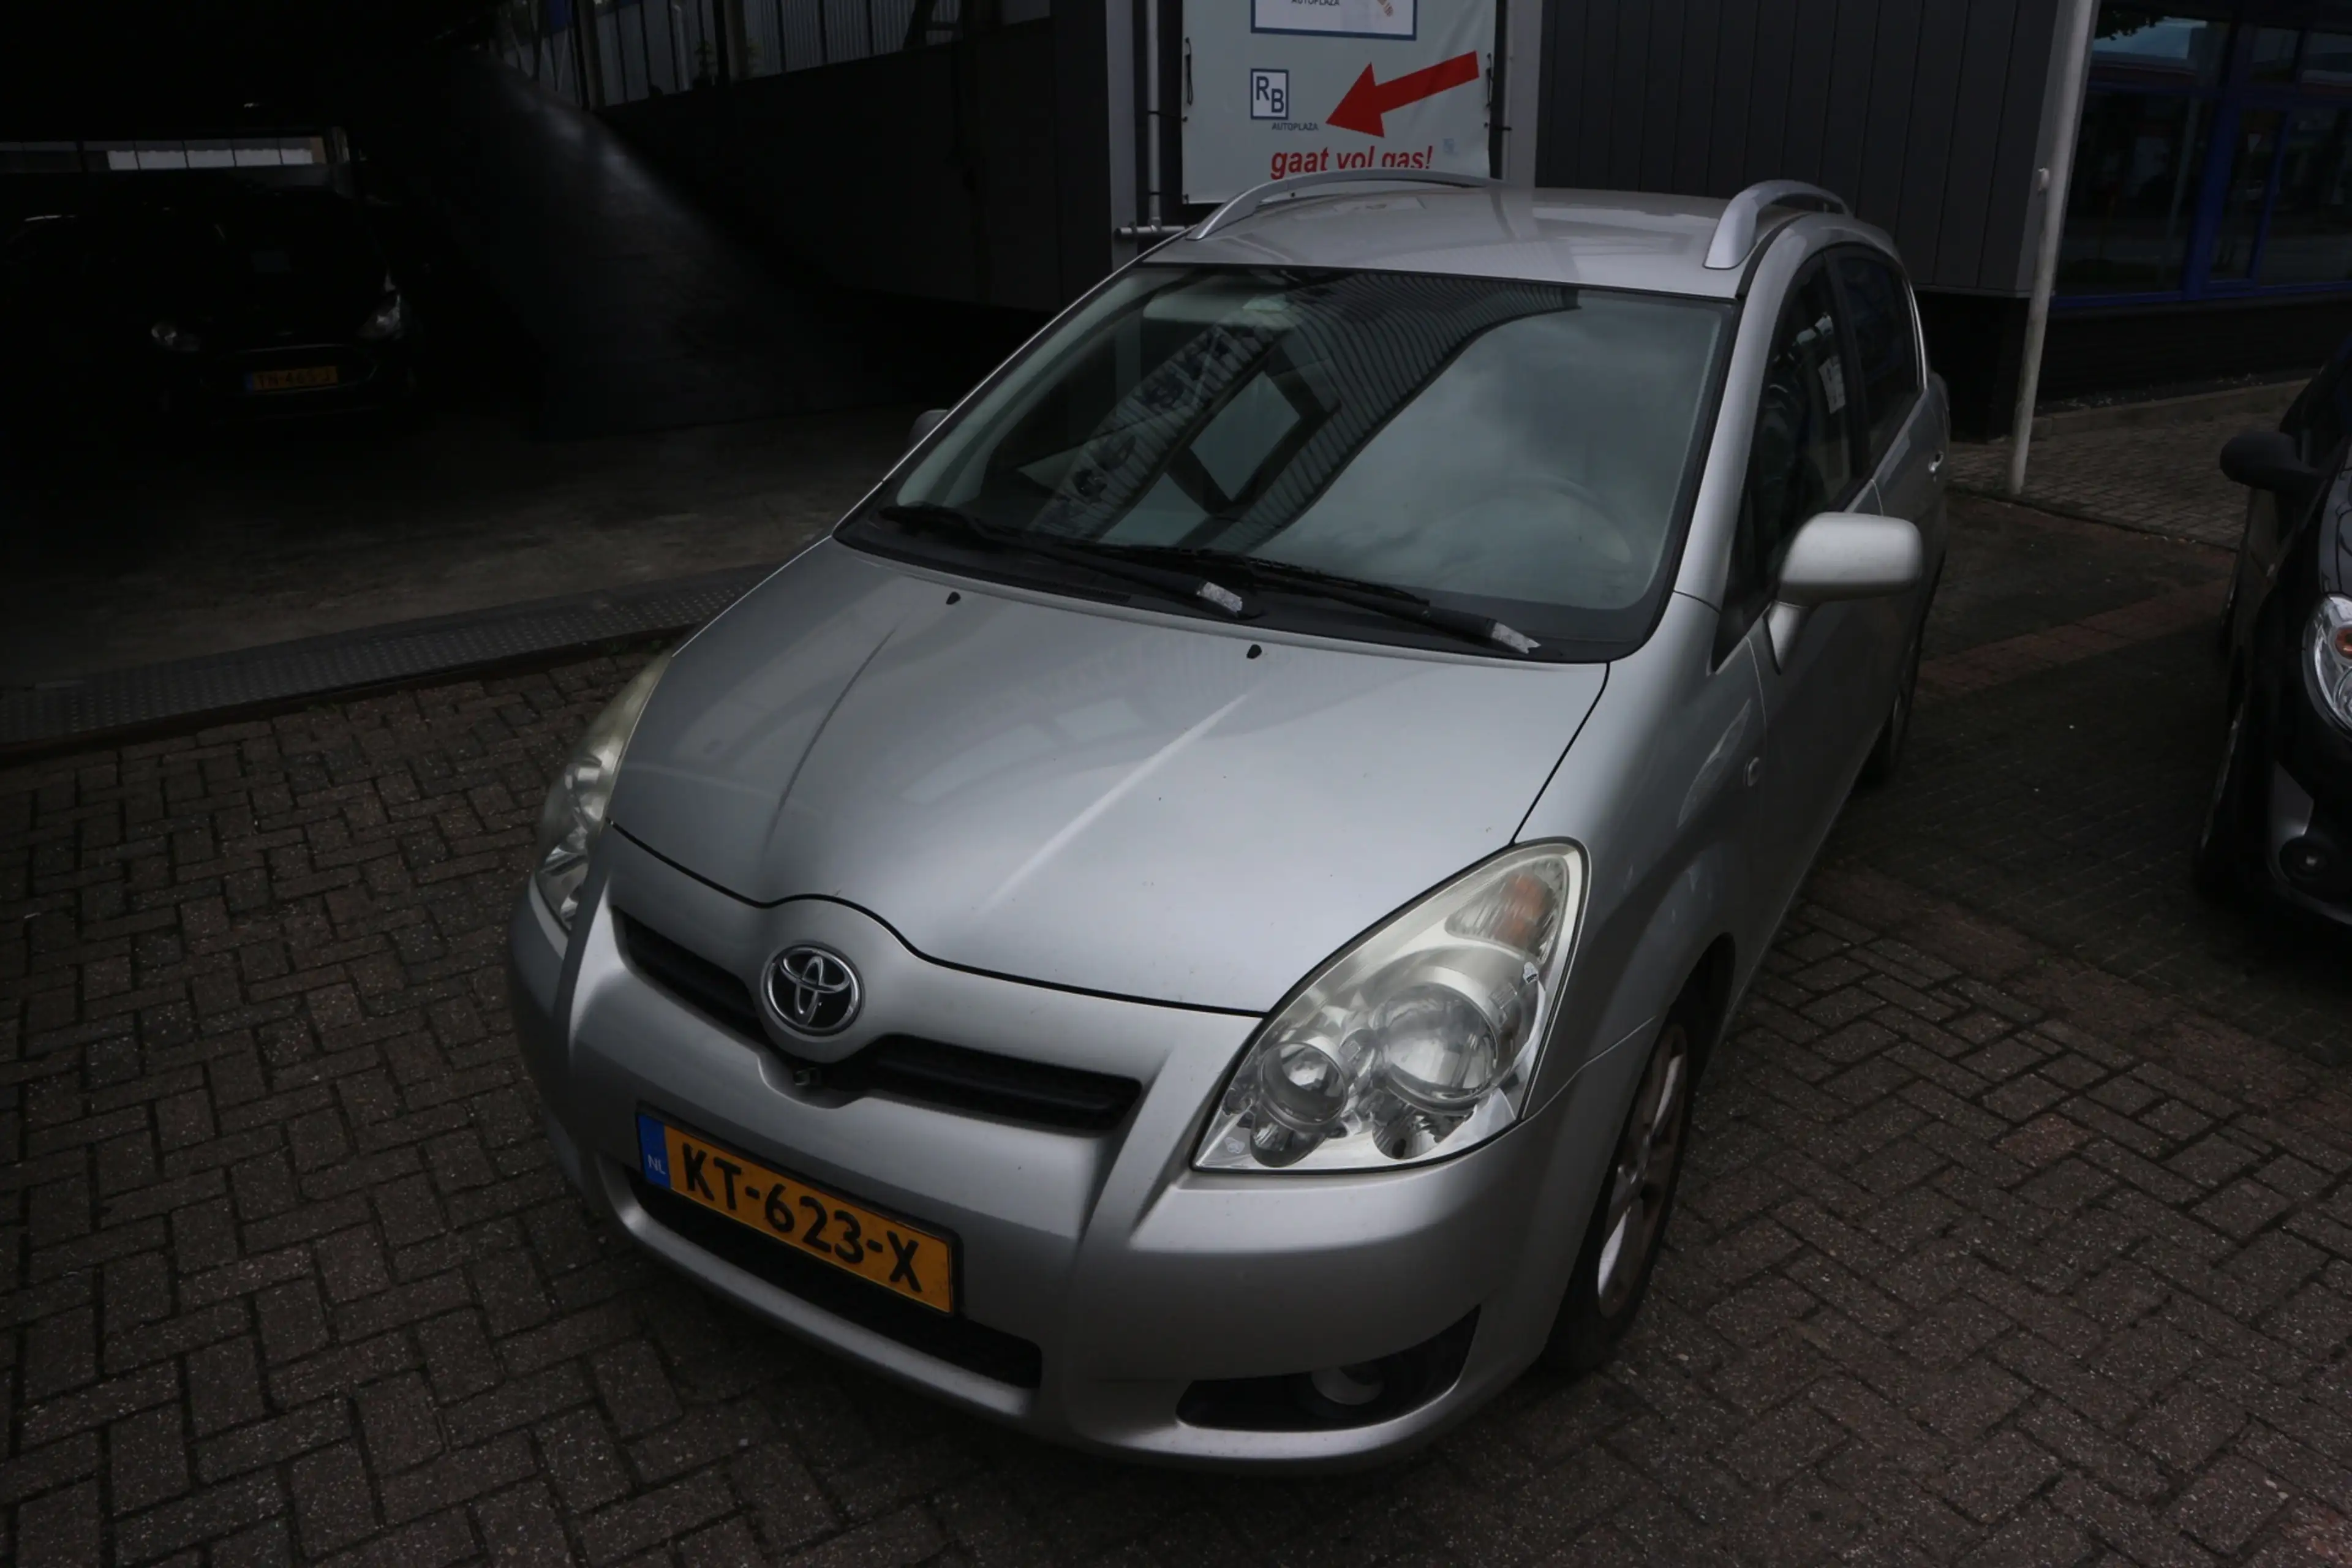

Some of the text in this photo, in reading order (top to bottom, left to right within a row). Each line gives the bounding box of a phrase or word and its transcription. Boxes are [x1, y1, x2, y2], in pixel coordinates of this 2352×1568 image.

[1271, 147, 1329, 179] gaat
[1337, 146, 1374, 168] vol
[647, 1154, 666, 1175] NL
[682, 1142, 922, 1292] KT-623-X
